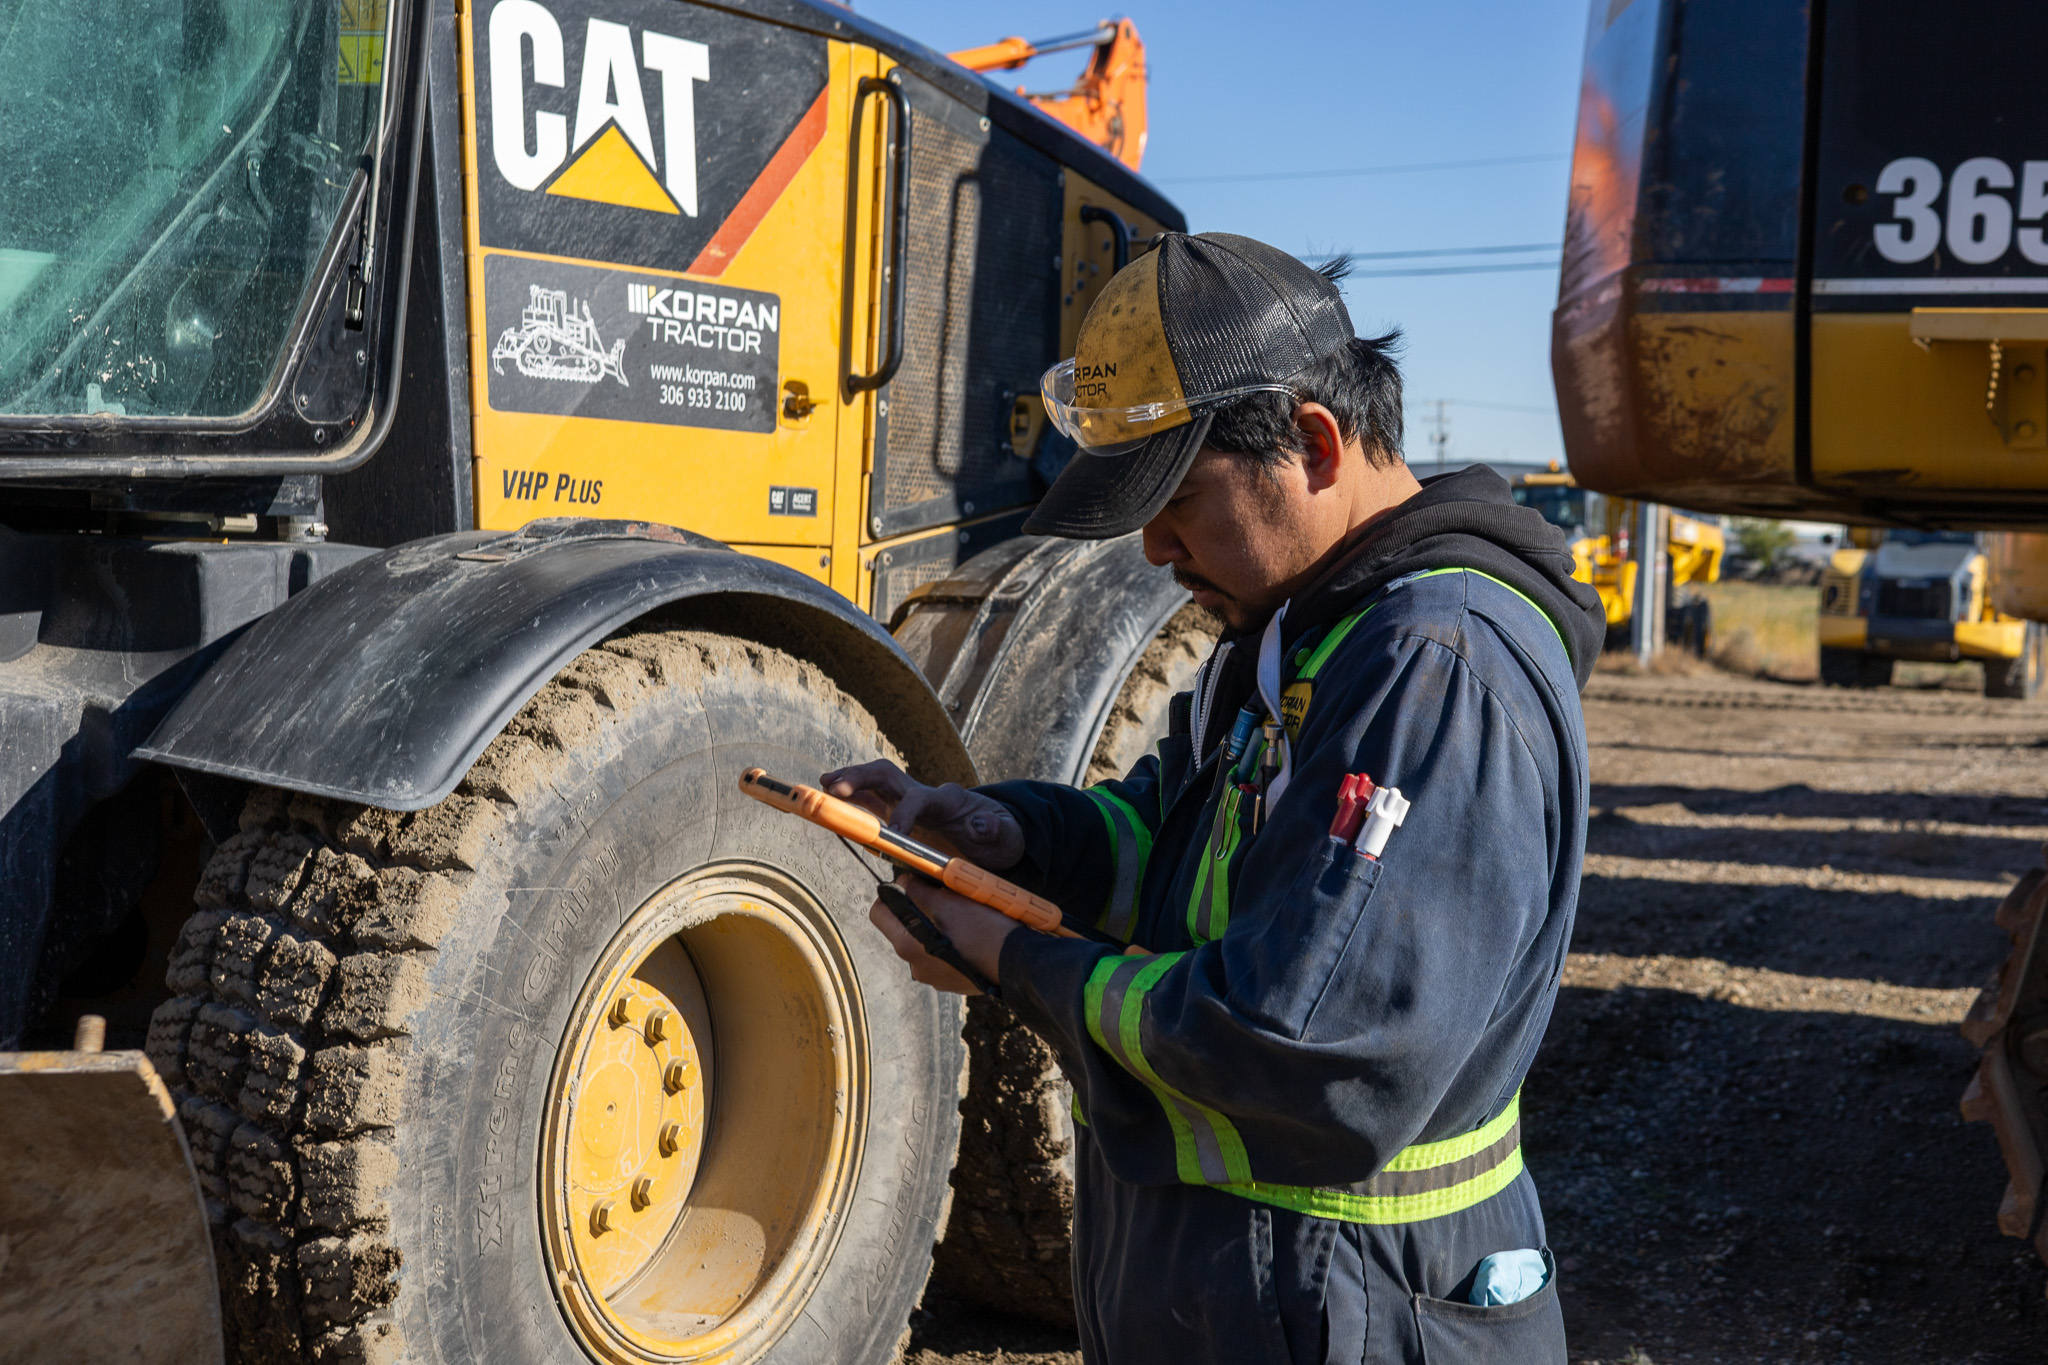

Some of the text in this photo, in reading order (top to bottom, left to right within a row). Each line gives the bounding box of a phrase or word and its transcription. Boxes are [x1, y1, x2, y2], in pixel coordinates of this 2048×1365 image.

[489, 0, 710, 217] CAT
[645, 286, 778, 333] KORPAN
[646, 317, 761, 355] TRACTOR
[650, 363, 756, 390] www.korpan.com
[1074, 362, 1117, 381] RPAN
[659, 384, 746, 412] 306 933 2100
[1074, 382, 1107, 398] CTOR
[503, 469, 549, 501] VHP
[478, 1020, 528, 1258] Xtreme
